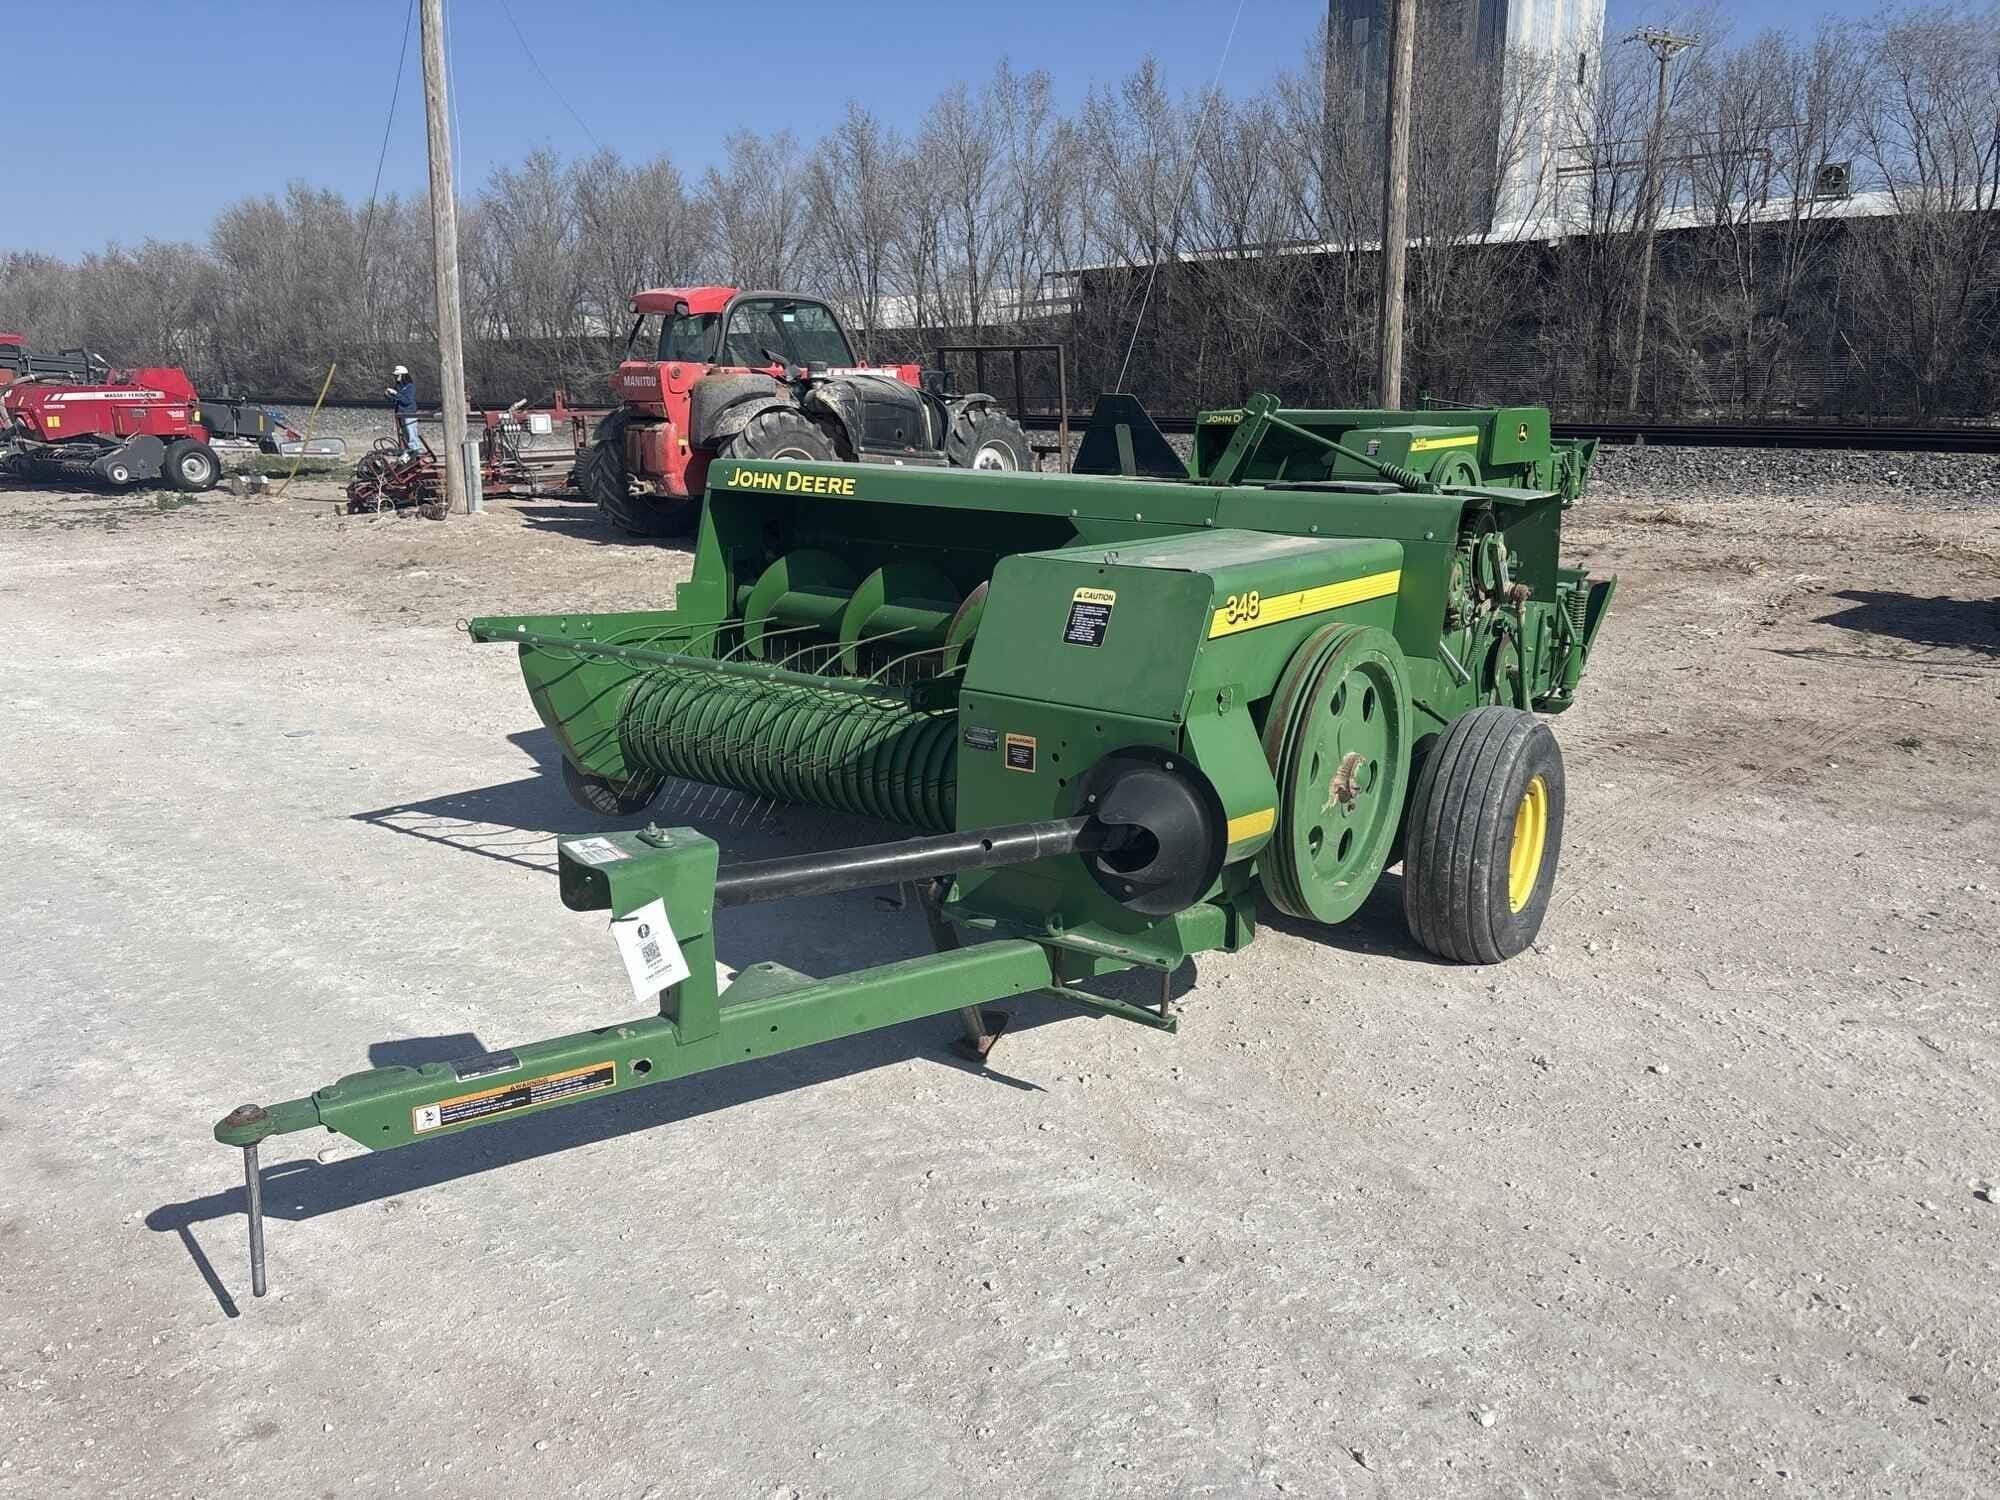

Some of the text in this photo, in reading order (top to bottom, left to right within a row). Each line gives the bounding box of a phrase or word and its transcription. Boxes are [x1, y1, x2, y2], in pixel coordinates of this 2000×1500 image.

[623, 375, 657, 387] MANITOU
[1206, 414, 1232, 423] JOHN
[728, 467, 856, 496] JOHN DEERE
[1083, 591, 1114, 601] CAUTION
[1226, 590, 1260, 624] 348
